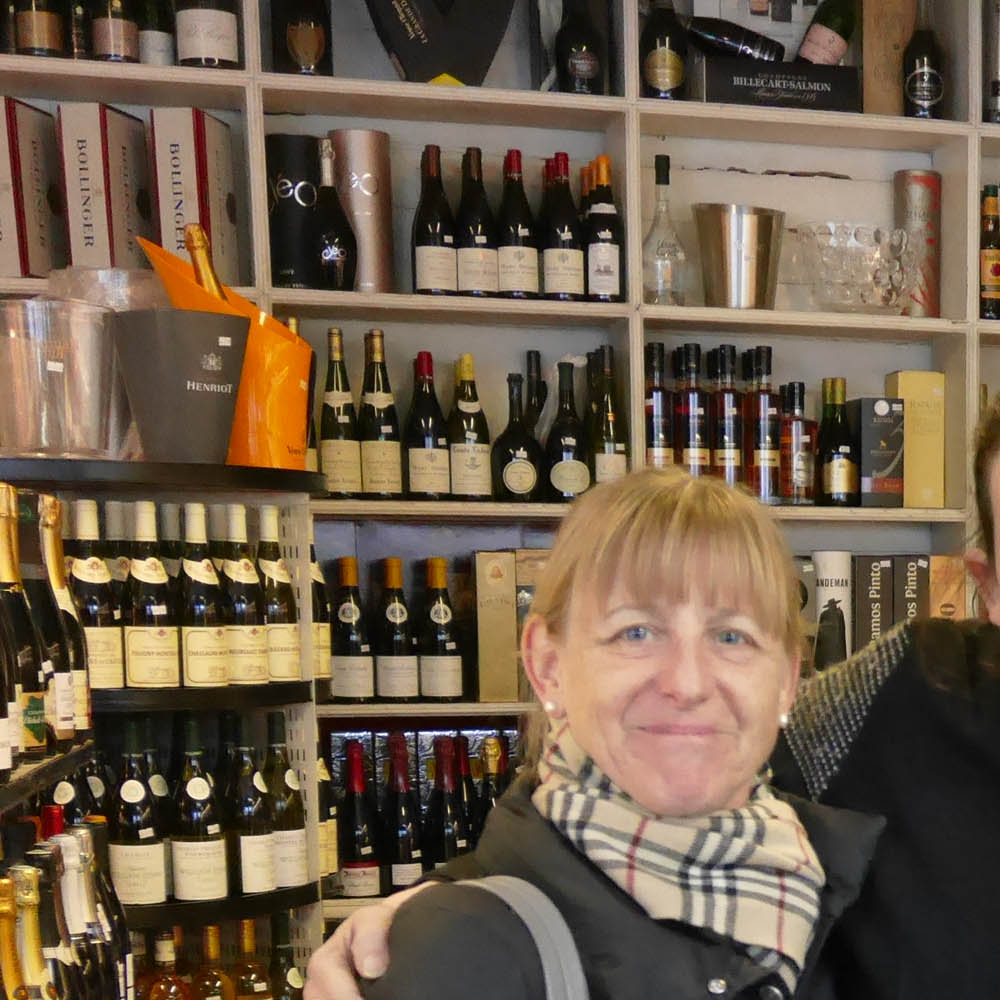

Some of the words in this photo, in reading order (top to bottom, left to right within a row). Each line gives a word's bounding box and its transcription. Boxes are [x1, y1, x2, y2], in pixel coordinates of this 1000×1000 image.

[732, 75, 832, 92] BILLECART-SALMON
[76, 138, 95, 248] BOLLINGER
[169, 142, 187, 251] BOLLINGER
[186, 379, 233, 395] HENRIOT
[868, 561, 881, 599] Pinto
[904, 561, 918, 599] Pinto
[870, 602, 881, 641] amos
[906, 601, 918, 619] os
